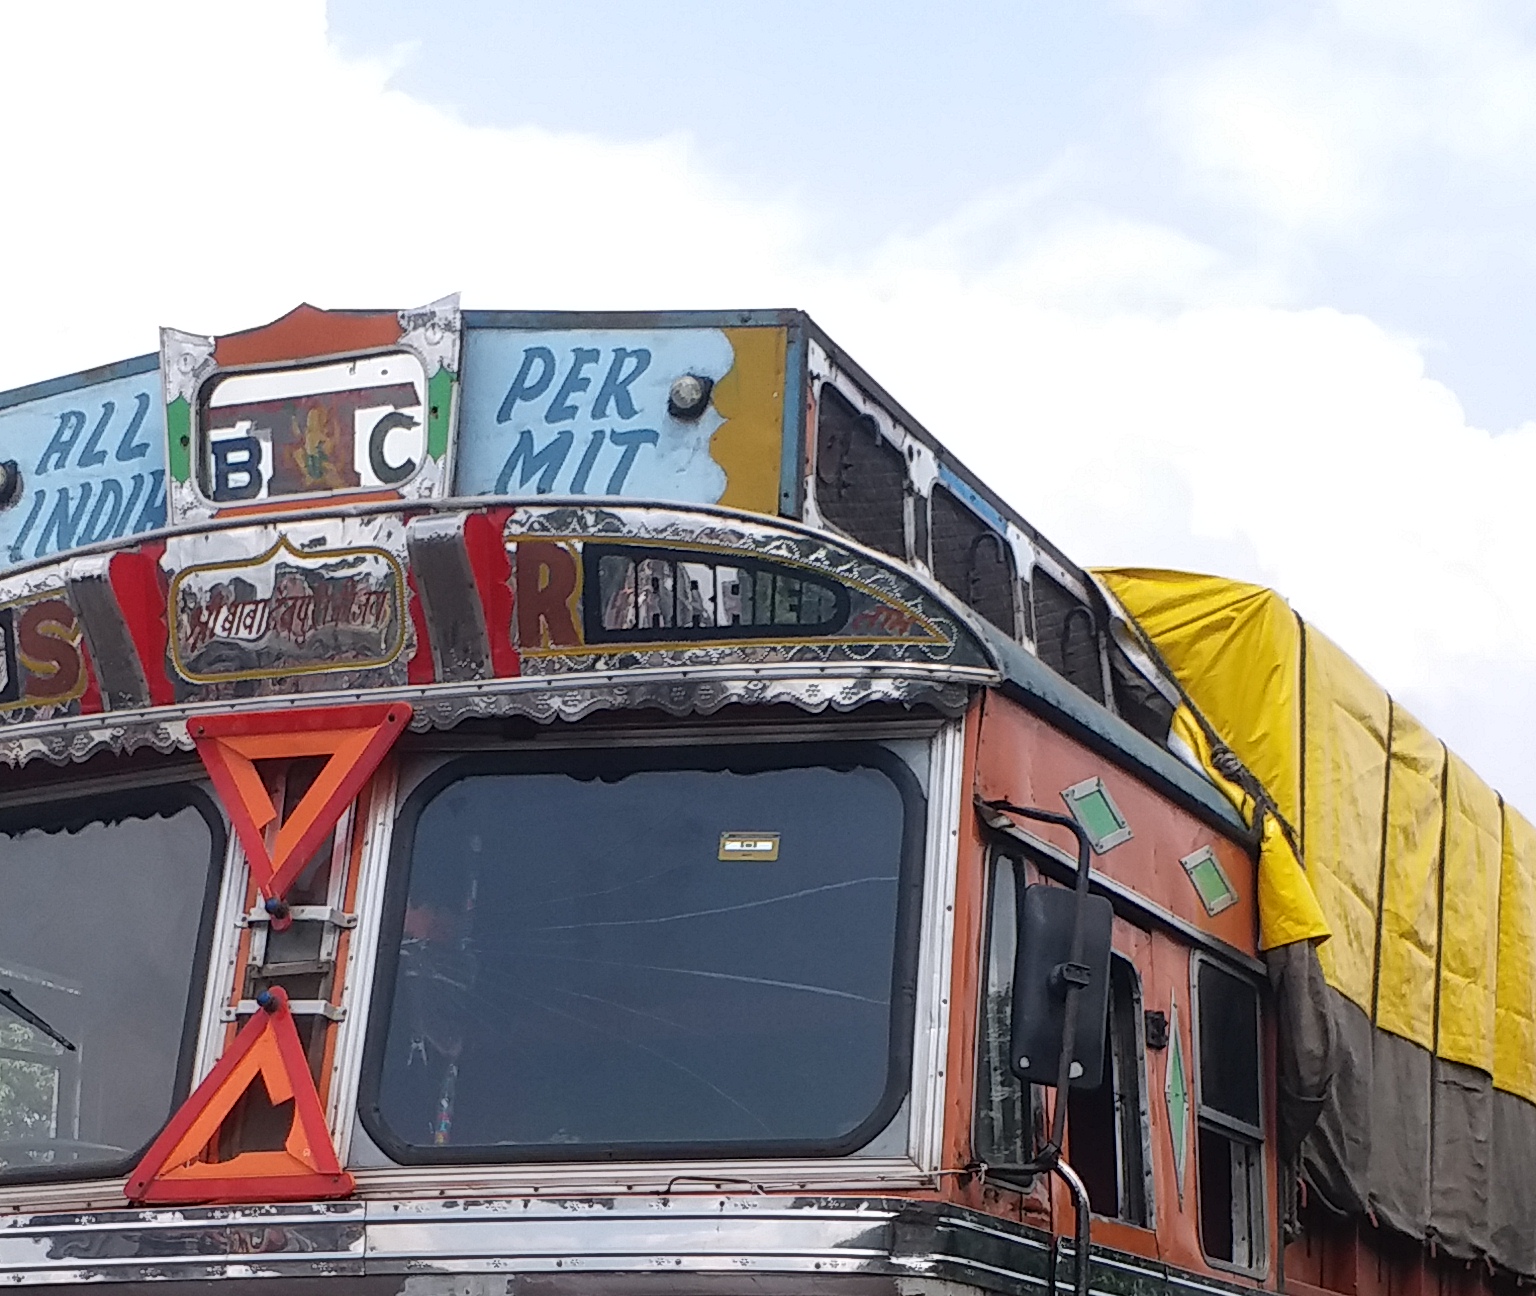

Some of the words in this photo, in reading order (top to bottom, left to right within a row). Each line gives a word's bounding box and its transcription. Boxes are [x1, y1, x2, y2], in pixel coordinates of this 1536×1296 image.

[496, 346, 652, 425] PER
[35, 392, 151, 476] ALL
[211, 436, 262, 501] B
[369, 411, 421, 484] C
[494, 428, 660, 495] MIT
[515, 540, 584, 647] R
[19, 600, 86, 701] S
